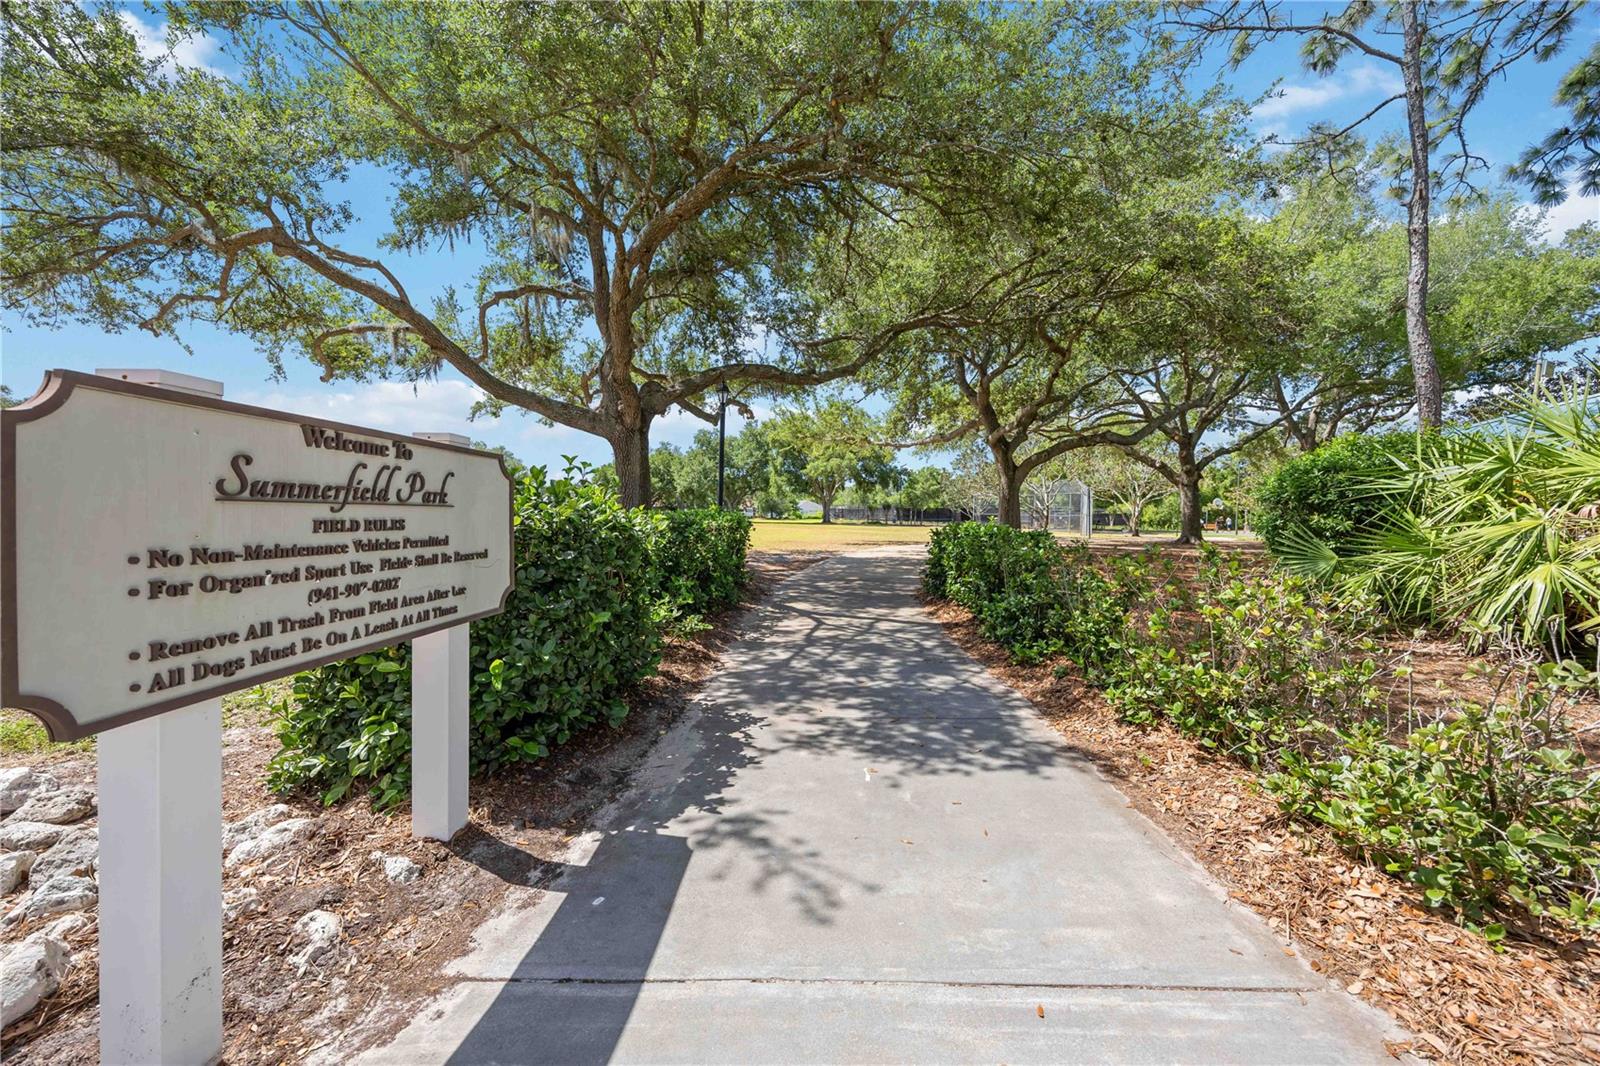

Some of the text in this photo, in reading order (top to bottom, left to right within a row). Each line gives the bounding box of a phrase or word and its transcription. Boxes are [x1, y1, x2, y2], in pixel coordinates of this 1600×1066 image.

[301, 424, 413, 460] Welcome To
[214, 451, 454, 513] Summerfield Park
[312, 518, 406, 534] FIELD RULES
[147, 535, 449, 568] No Non-Maintenance Vehicles Permitted
[148, 580, 193, 600] For
[304, 565, 347, 582] Sport
[351, 562, 374, 575] Use
[415, 555, 440, 567] Shall
[441, 552, 453, 564] Be
[453, 550, 488, 561] Reserved
[148, 630, 239, 662] Remove
[245, 622, 273, 641] All
[278, 612, 325, 634] Trash
[329, 606, 366, 624] From
[369, 597, 399, 614] Field
[400, 594, 426, 608] Area
[427, 590, 450, 602] After
[148, 605, 458, 694] All Dogs Must Be On A Leash At All Times
